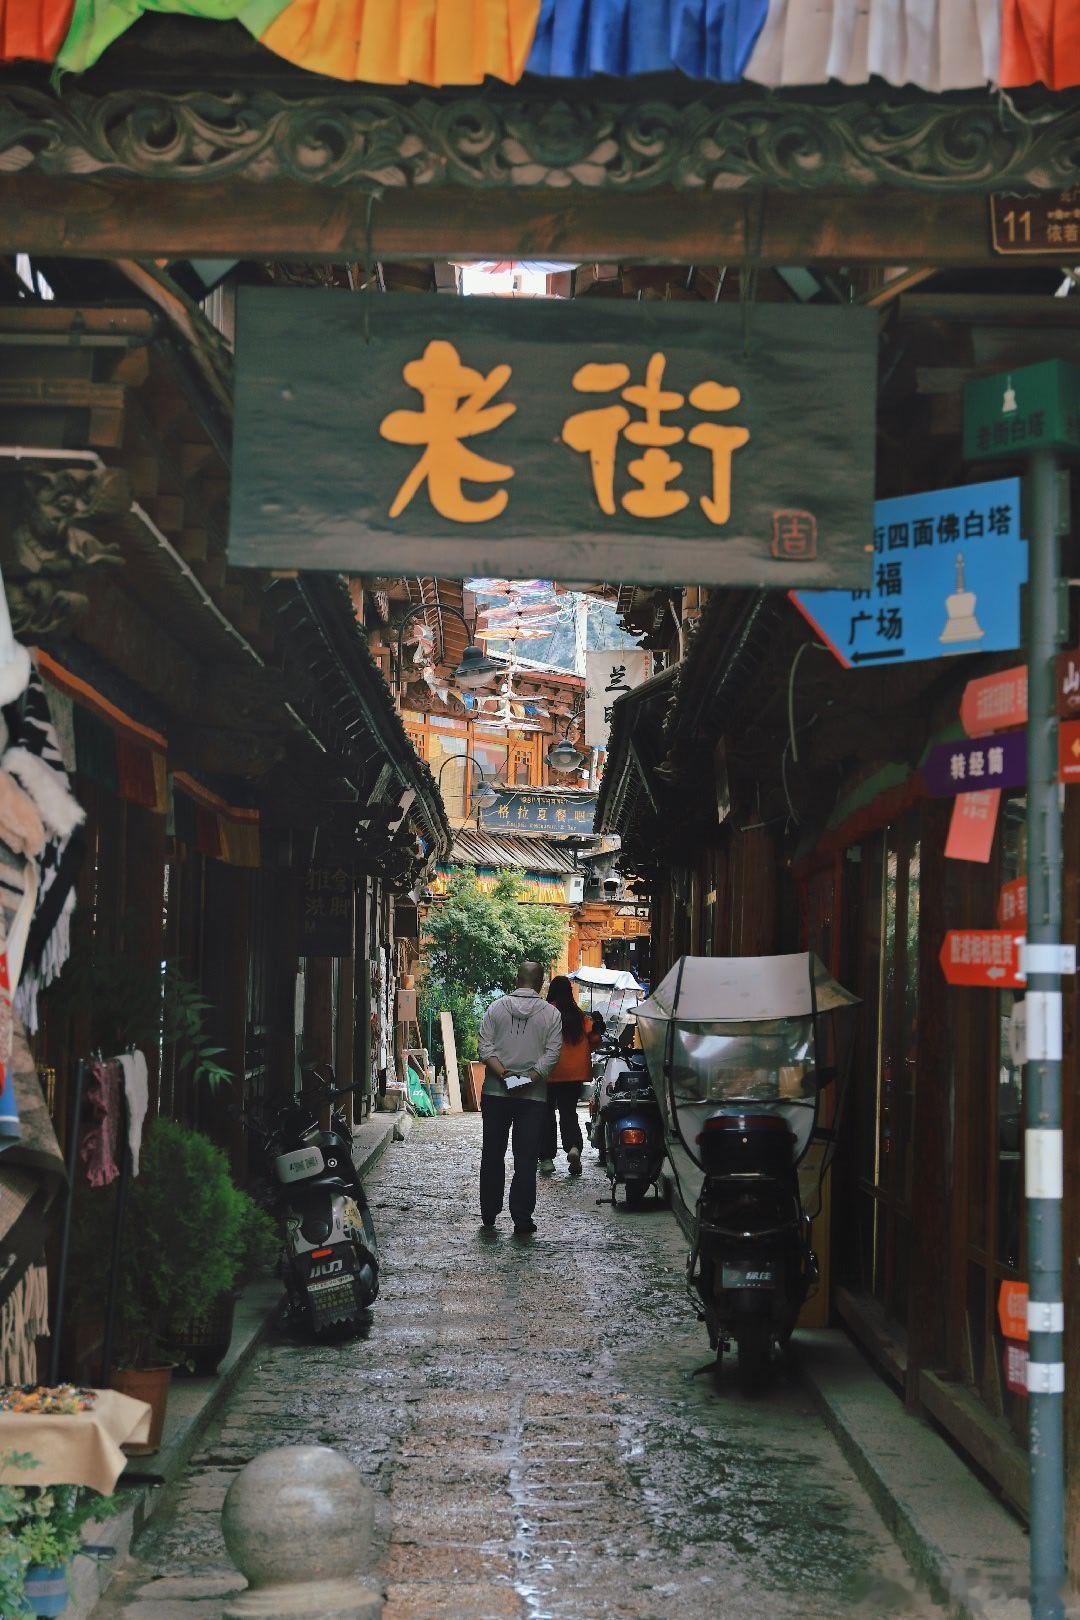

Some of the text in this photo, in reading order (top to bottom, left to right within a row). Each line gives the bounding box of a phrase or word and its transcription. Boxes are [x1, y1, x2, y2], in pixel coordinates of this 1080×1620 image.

[1003, 210, 1031, 242] 11
[379, 339, 751, 525] 老街
[851, 562, 902, 601] 福
[849, 608, 902, 644] 广场
[950, 746, 1004, 779] 转经筒
